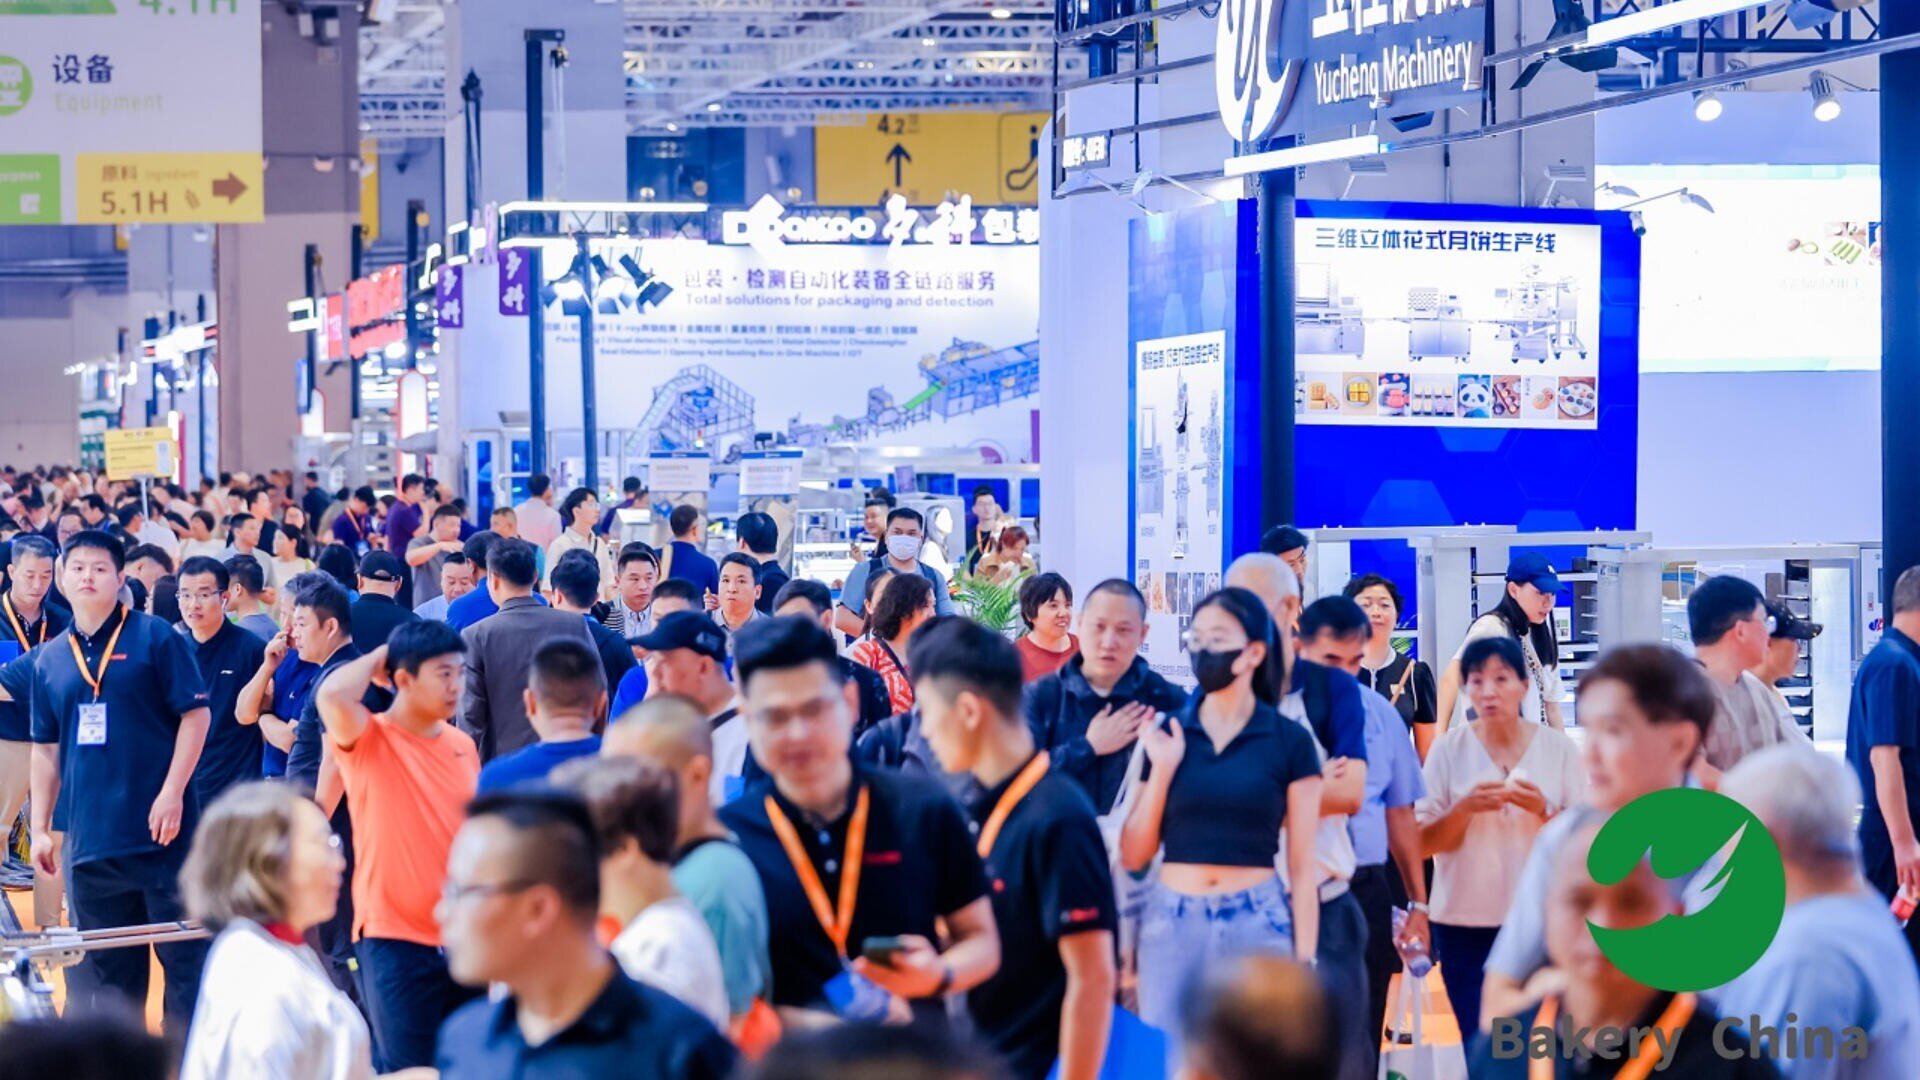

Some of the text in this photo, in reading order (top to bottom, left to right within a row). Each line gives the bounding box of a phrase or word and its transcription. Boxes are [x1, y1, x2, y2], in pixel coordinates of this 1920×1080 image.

[53, 54, 115, 84] 设备
[1314, 36, 1472, 109] Yucheng Machinery
[54, 93, 164, 114] Equipment
[101, 191, 168, 215] 5.1H
[1315, 227, 1556, 253] 三维立体花式月饼生产线
[687, 294, 994, 309] Total solutions for packaging and detection
